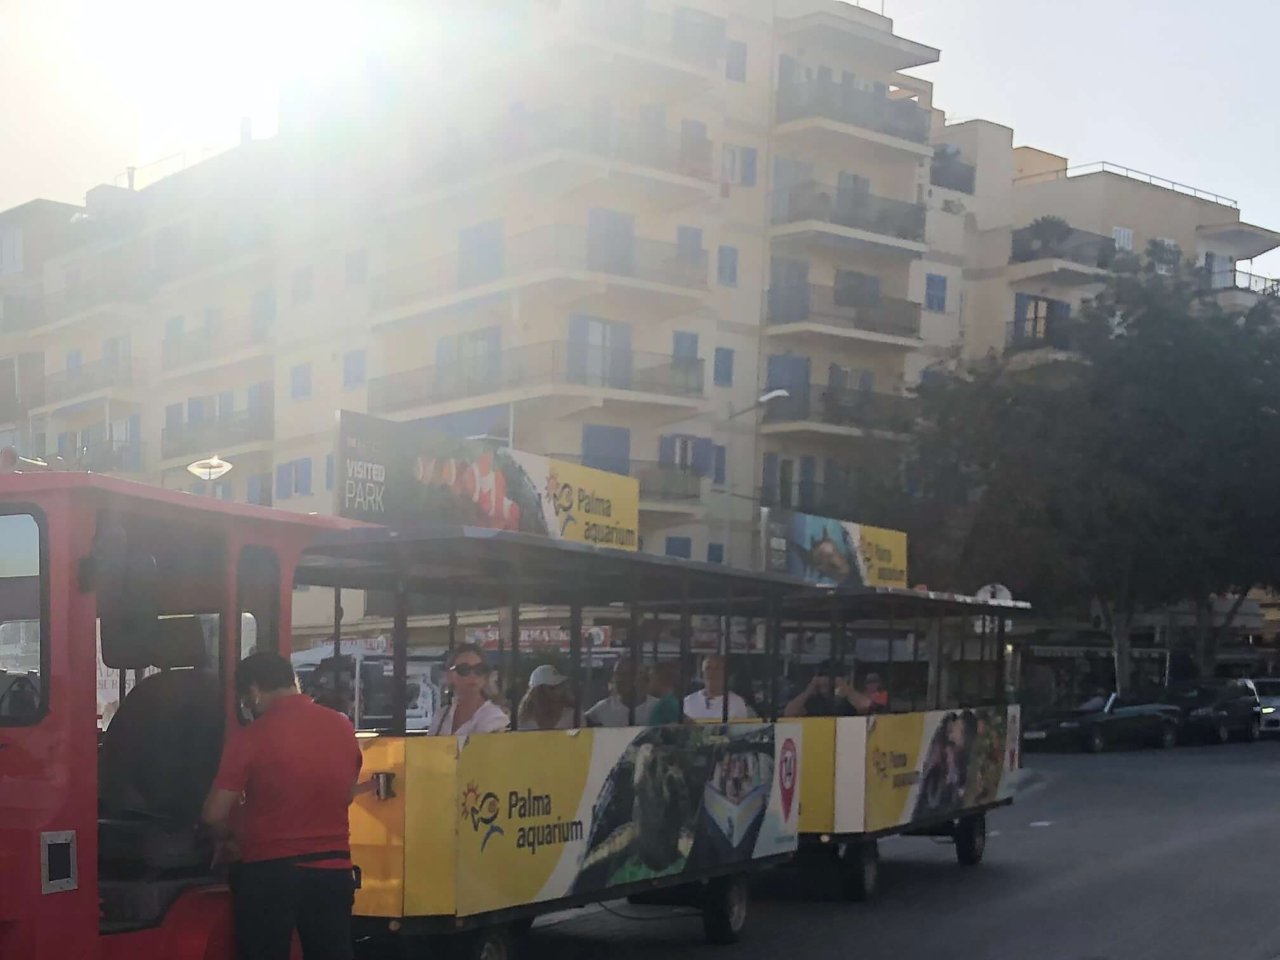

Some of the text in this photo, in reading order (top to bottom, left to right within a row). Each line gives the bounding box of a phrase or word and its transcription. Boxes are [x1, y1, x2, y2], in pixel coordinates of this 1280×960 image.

[346, 458, 385, 482] VISITED
[345, 480, 385, 513] PARK
[578, 487, 612, 518] Palma
[584, 520, 636, 546] aquarium
[508, 788, 552, 819] Palma
[516, 816, 584, 855] aquarium
